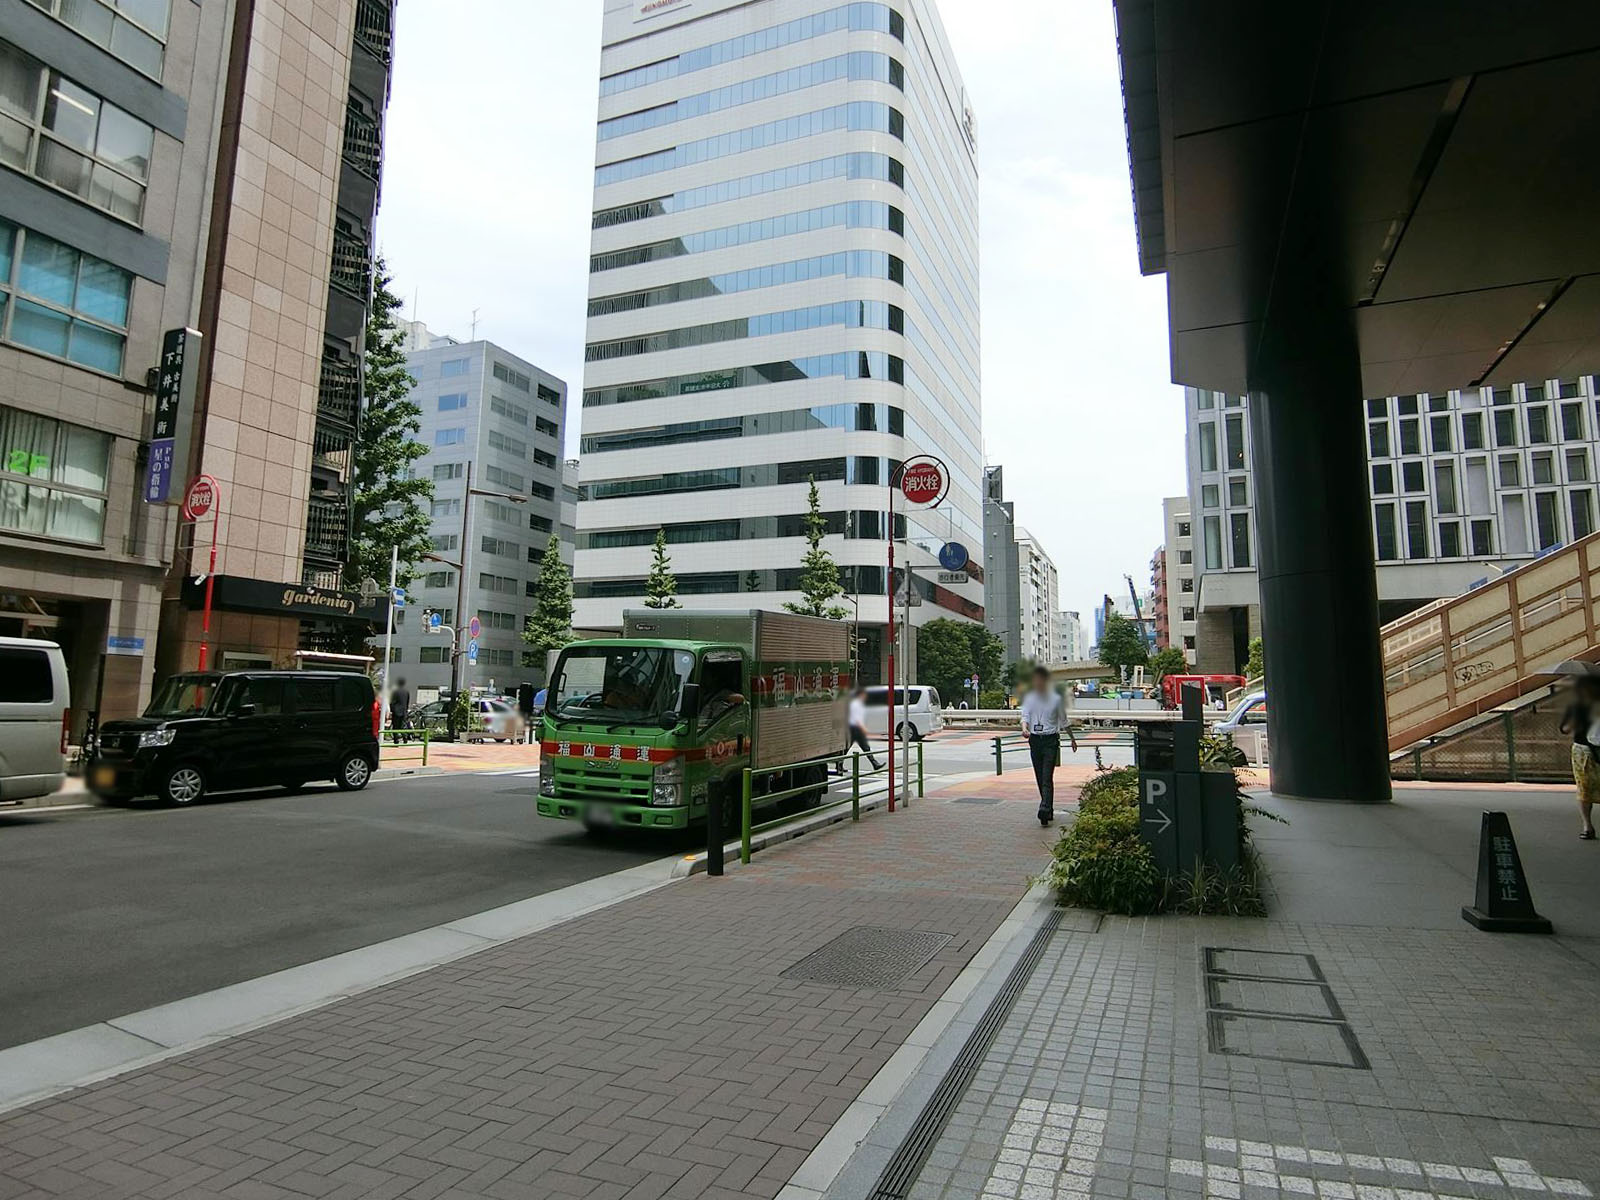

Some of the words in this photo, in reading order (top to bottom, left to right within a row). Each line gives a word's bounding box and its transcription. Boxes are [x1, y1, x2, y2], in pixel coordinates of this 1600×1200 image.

[904, 474, 939, 493] 消火栓
[191, 491, 211, 508] 消火栓
[282, 589, 355, 615] gardenia
[772, 666, 839, 701] 福山通運
[558, 741, 650, 762] 福山通運
[1146, 779, 1167, 805] P
[1493, 836, 1520, 901] 駐車禁止
